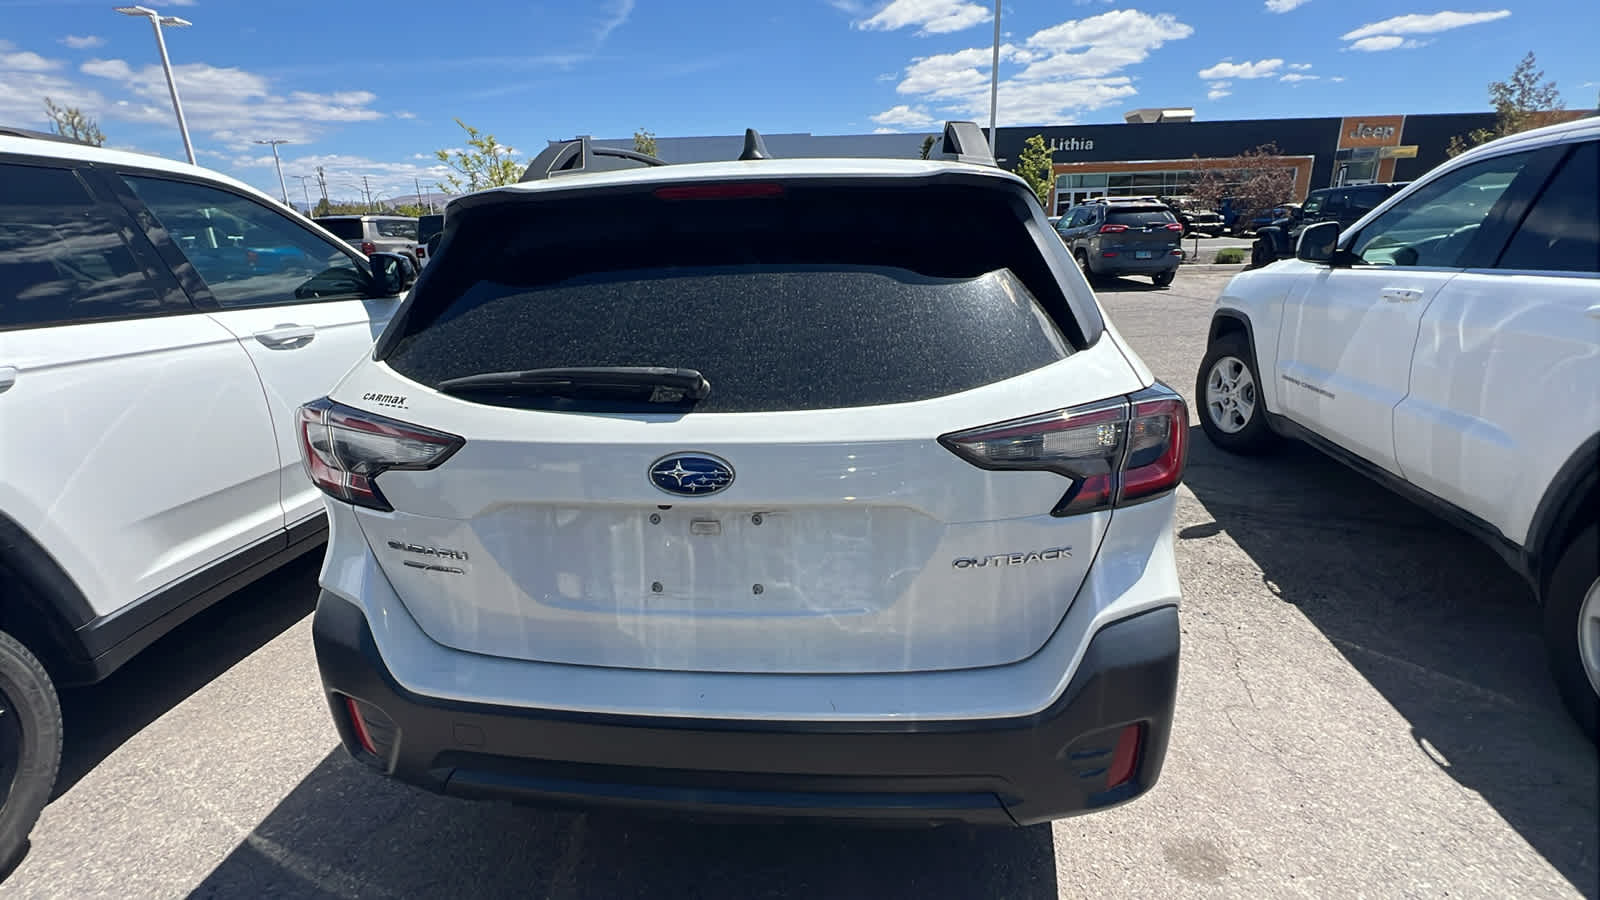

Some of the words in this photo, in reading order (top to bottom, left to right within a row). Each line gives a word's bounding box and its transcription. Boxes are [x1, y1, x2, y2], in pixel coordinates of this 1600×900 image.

[1349, 121, 1396, 140] Jeep
[1050, 137, 1094, 151] Lithia
[951, 546, 1073, 568] OUTBACK
